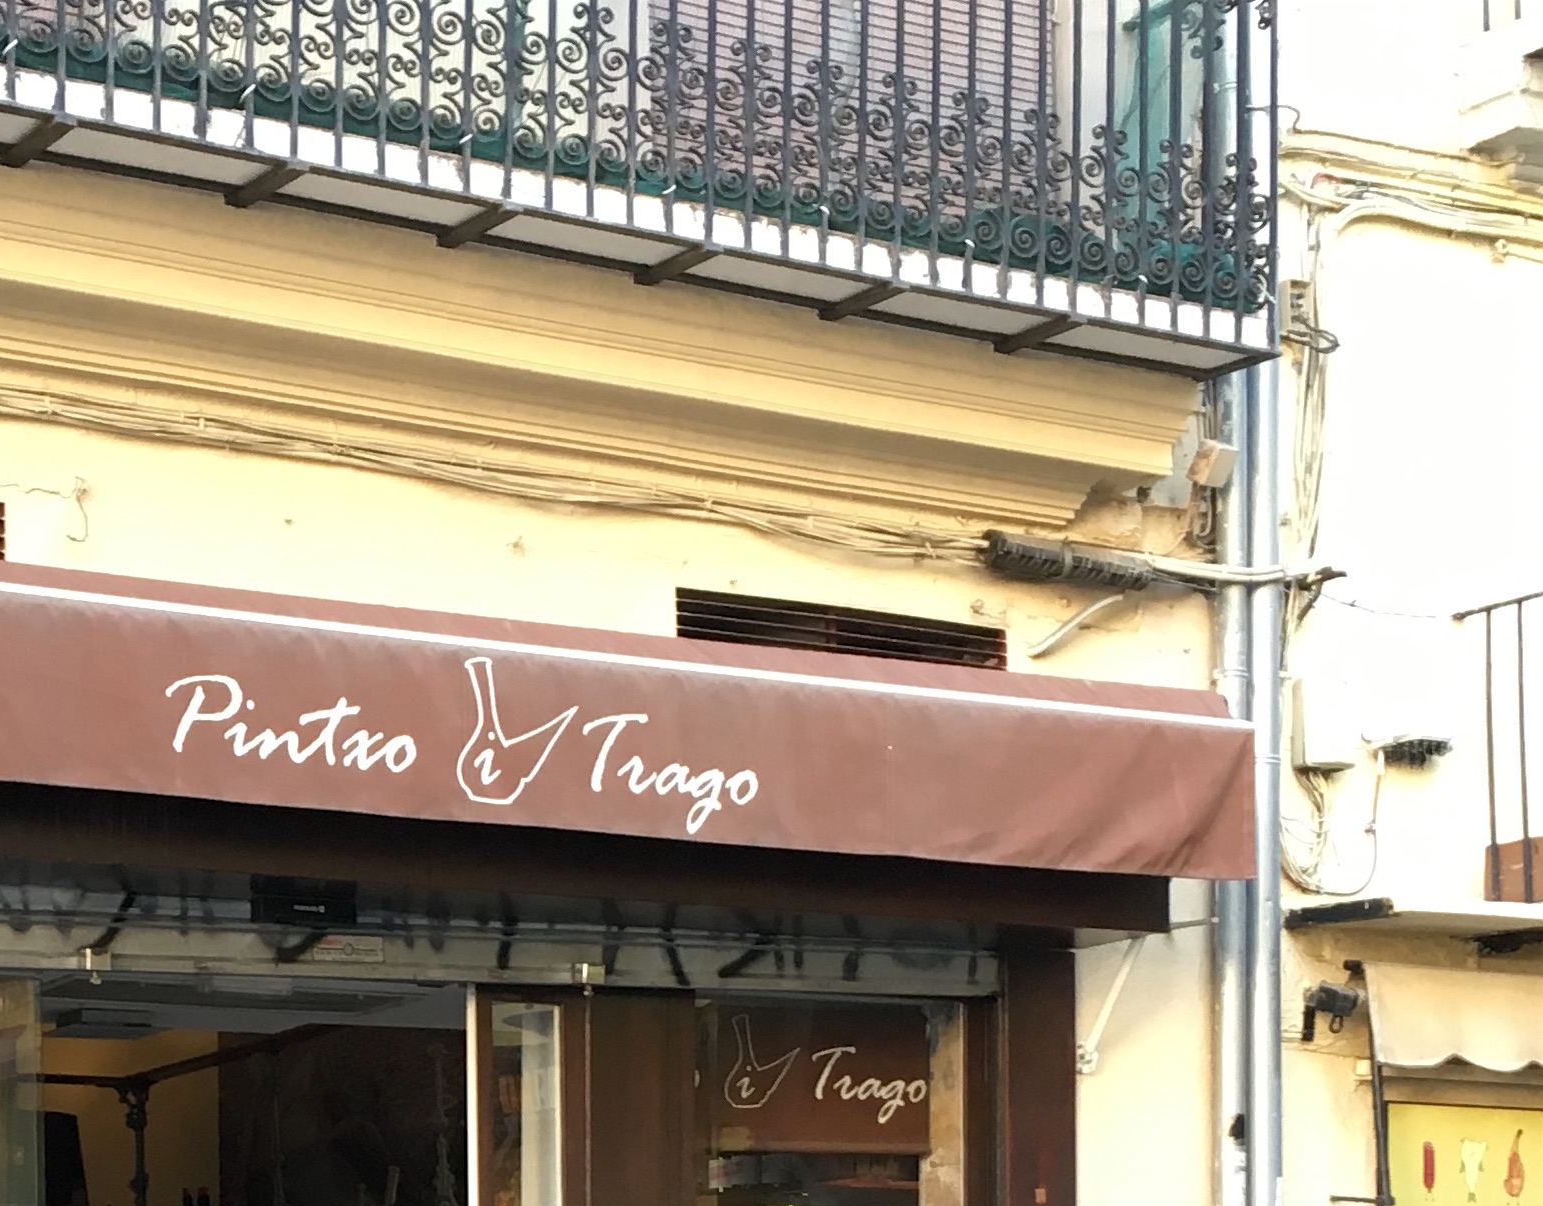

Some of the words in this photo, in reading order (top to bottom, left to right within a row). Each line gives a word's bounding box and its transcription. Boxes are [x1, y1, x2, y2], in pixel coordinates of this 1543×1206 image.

[165, 675, 417, 773] Pintxo
[582, 714, 759, 834] Trago
[812, 1046, 927, 1124] Trago
